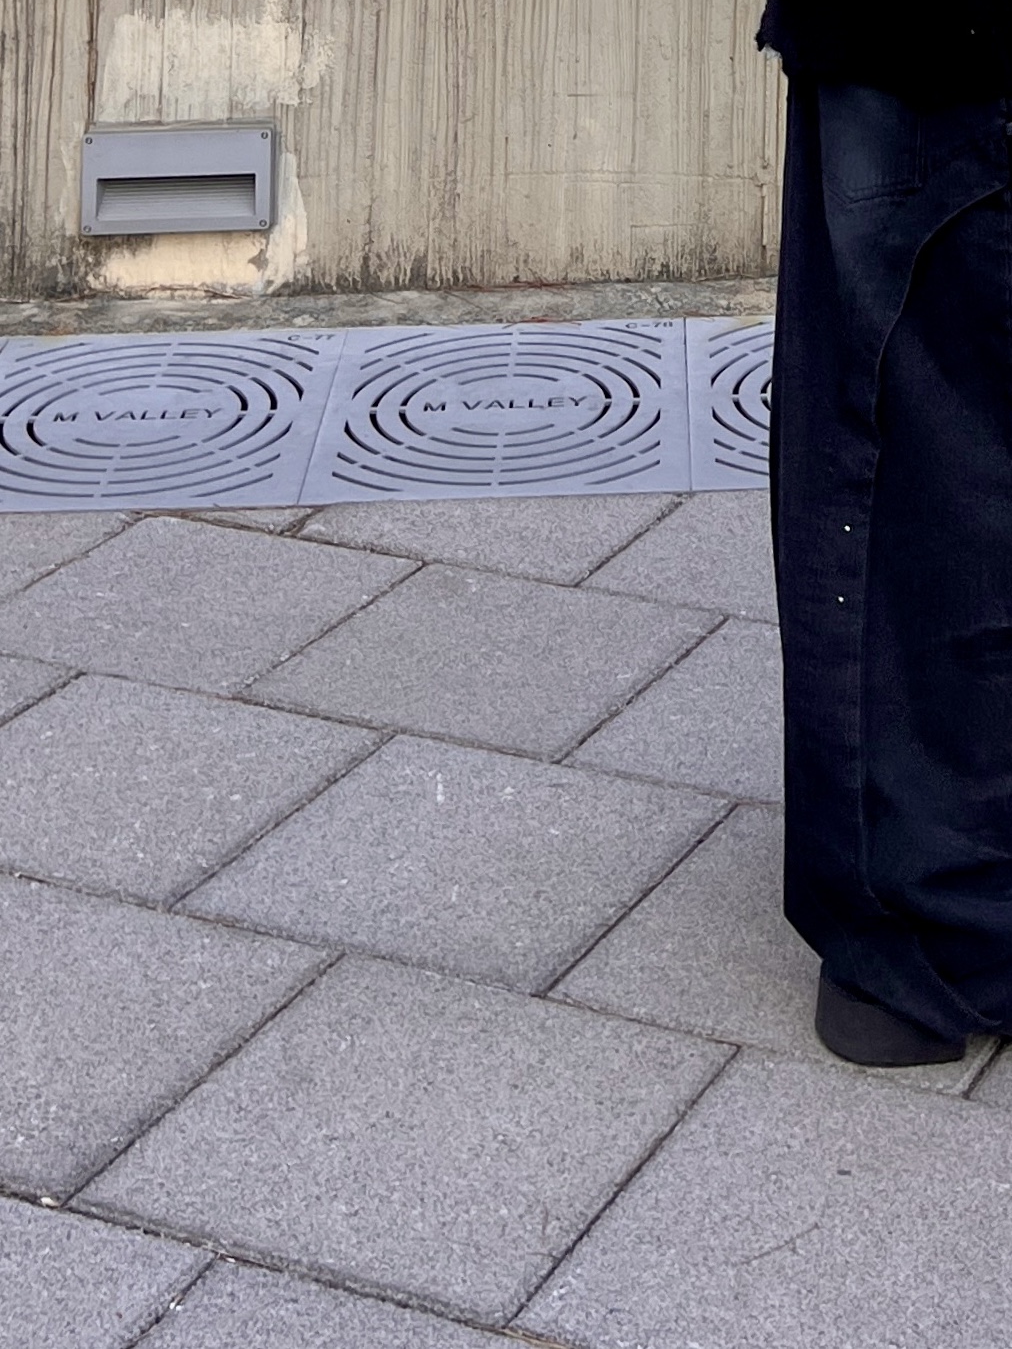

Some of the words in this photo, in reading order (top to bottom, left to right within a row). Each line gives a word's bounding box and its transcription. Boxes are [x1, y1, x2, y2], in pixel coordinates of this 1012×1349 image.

[423, 401, 447, 412] M
[462, 395, 588, 410] VALLEY
[52, 411, 79, 422] M
[94, 407, 224, 421] VALLEY
